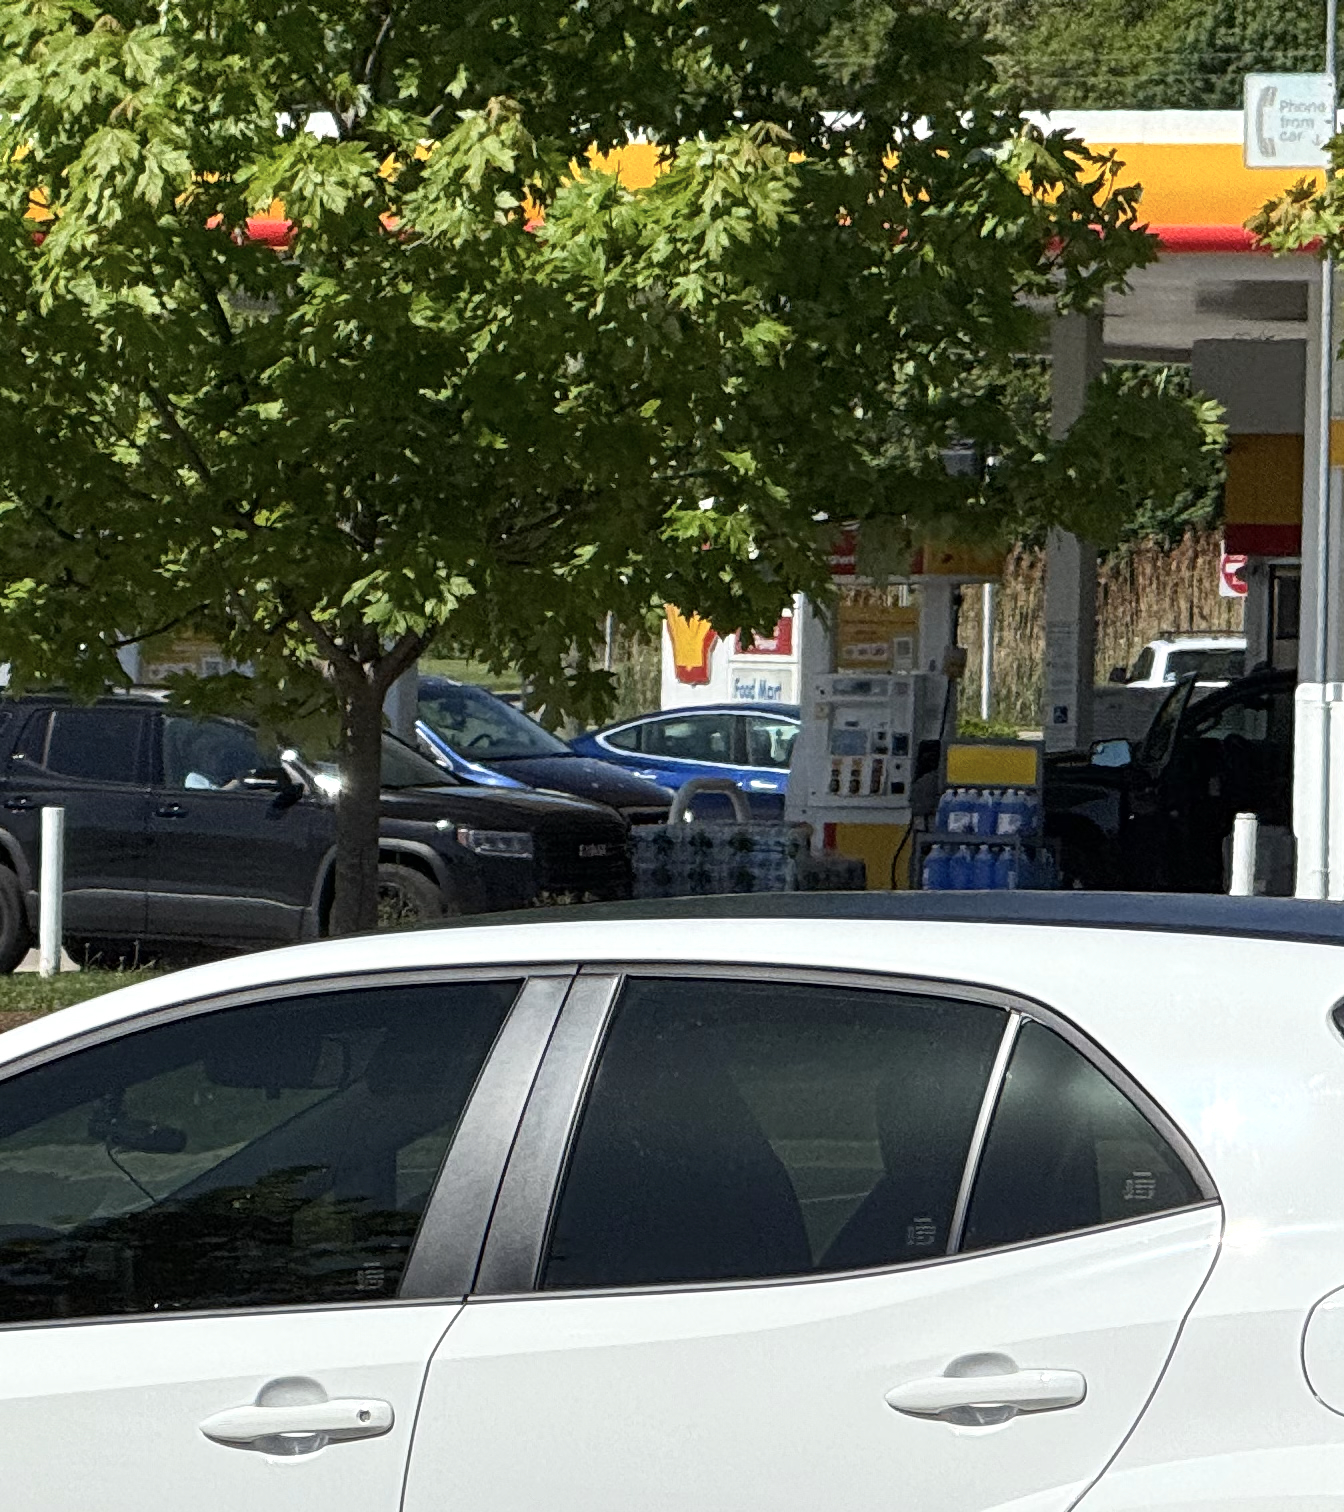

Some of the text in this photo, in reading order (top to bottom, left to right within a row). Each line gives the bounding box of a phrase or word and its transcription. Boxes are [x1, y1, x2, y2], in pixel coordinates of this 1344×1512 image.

[1280, 100, 1326, 113] Phone
[1280, 116, 1315, 129] from
[1279, 131, 1303, 142] car
[734, 677, 782, 699] Food Mart
